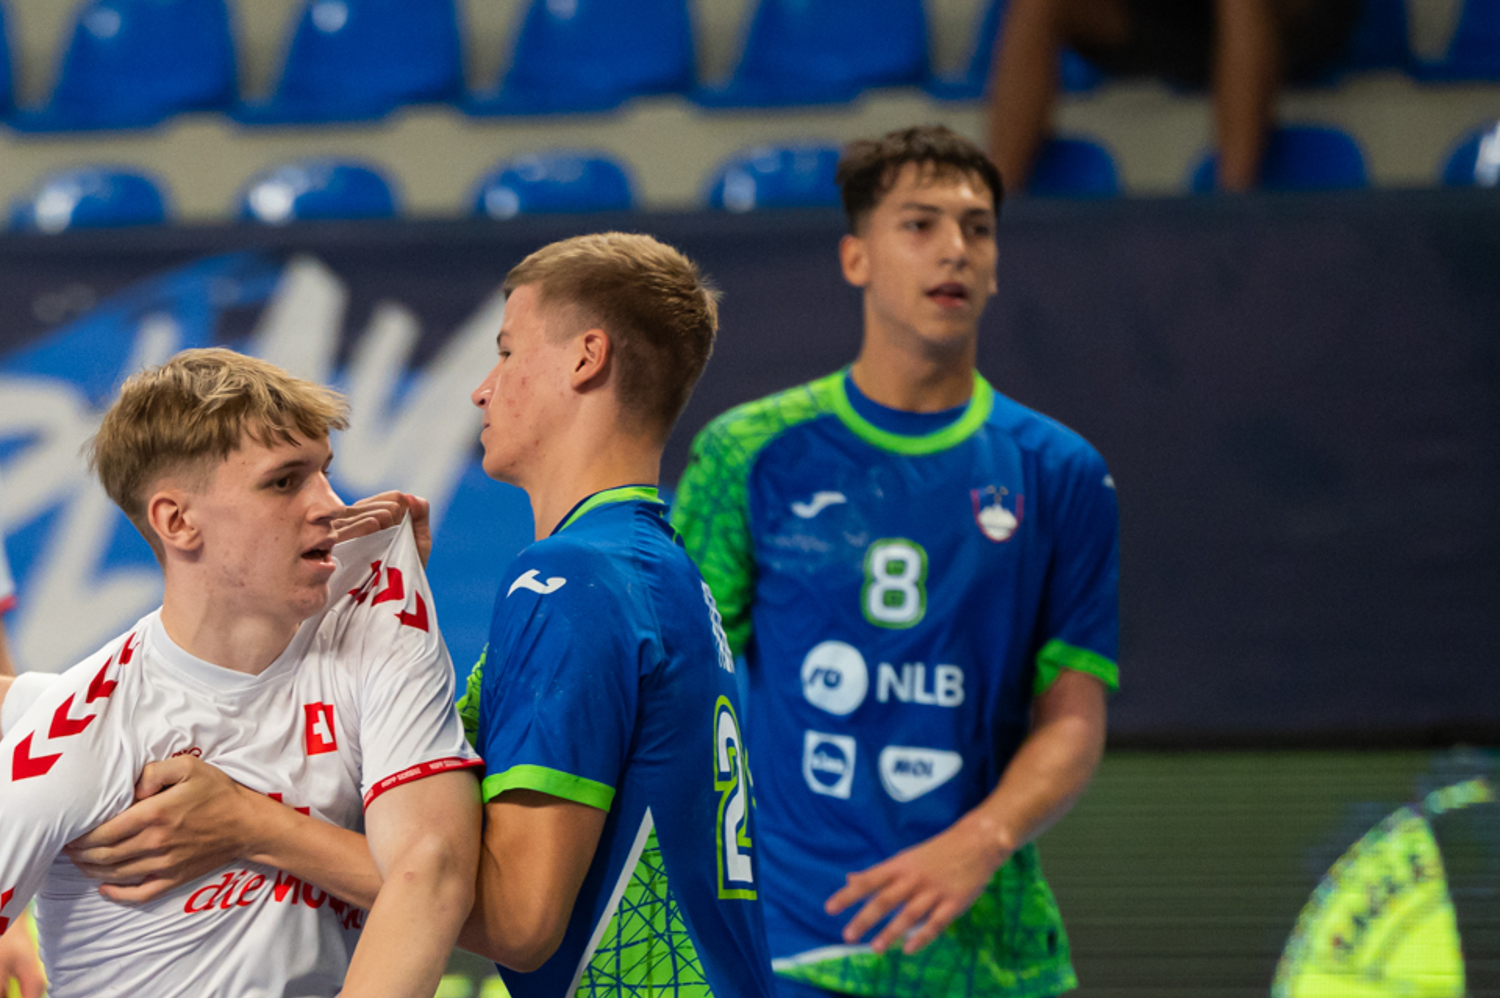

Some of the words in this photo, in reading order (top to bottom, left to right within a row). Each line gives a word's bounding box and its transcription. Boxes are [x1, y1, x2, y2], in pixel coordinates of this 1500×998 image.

[864, 540, 926, 627] 8
[876, 661, 966, 708] NLB
[715, 699, 758, 896] 2
[184, 870, 266, 914] die
